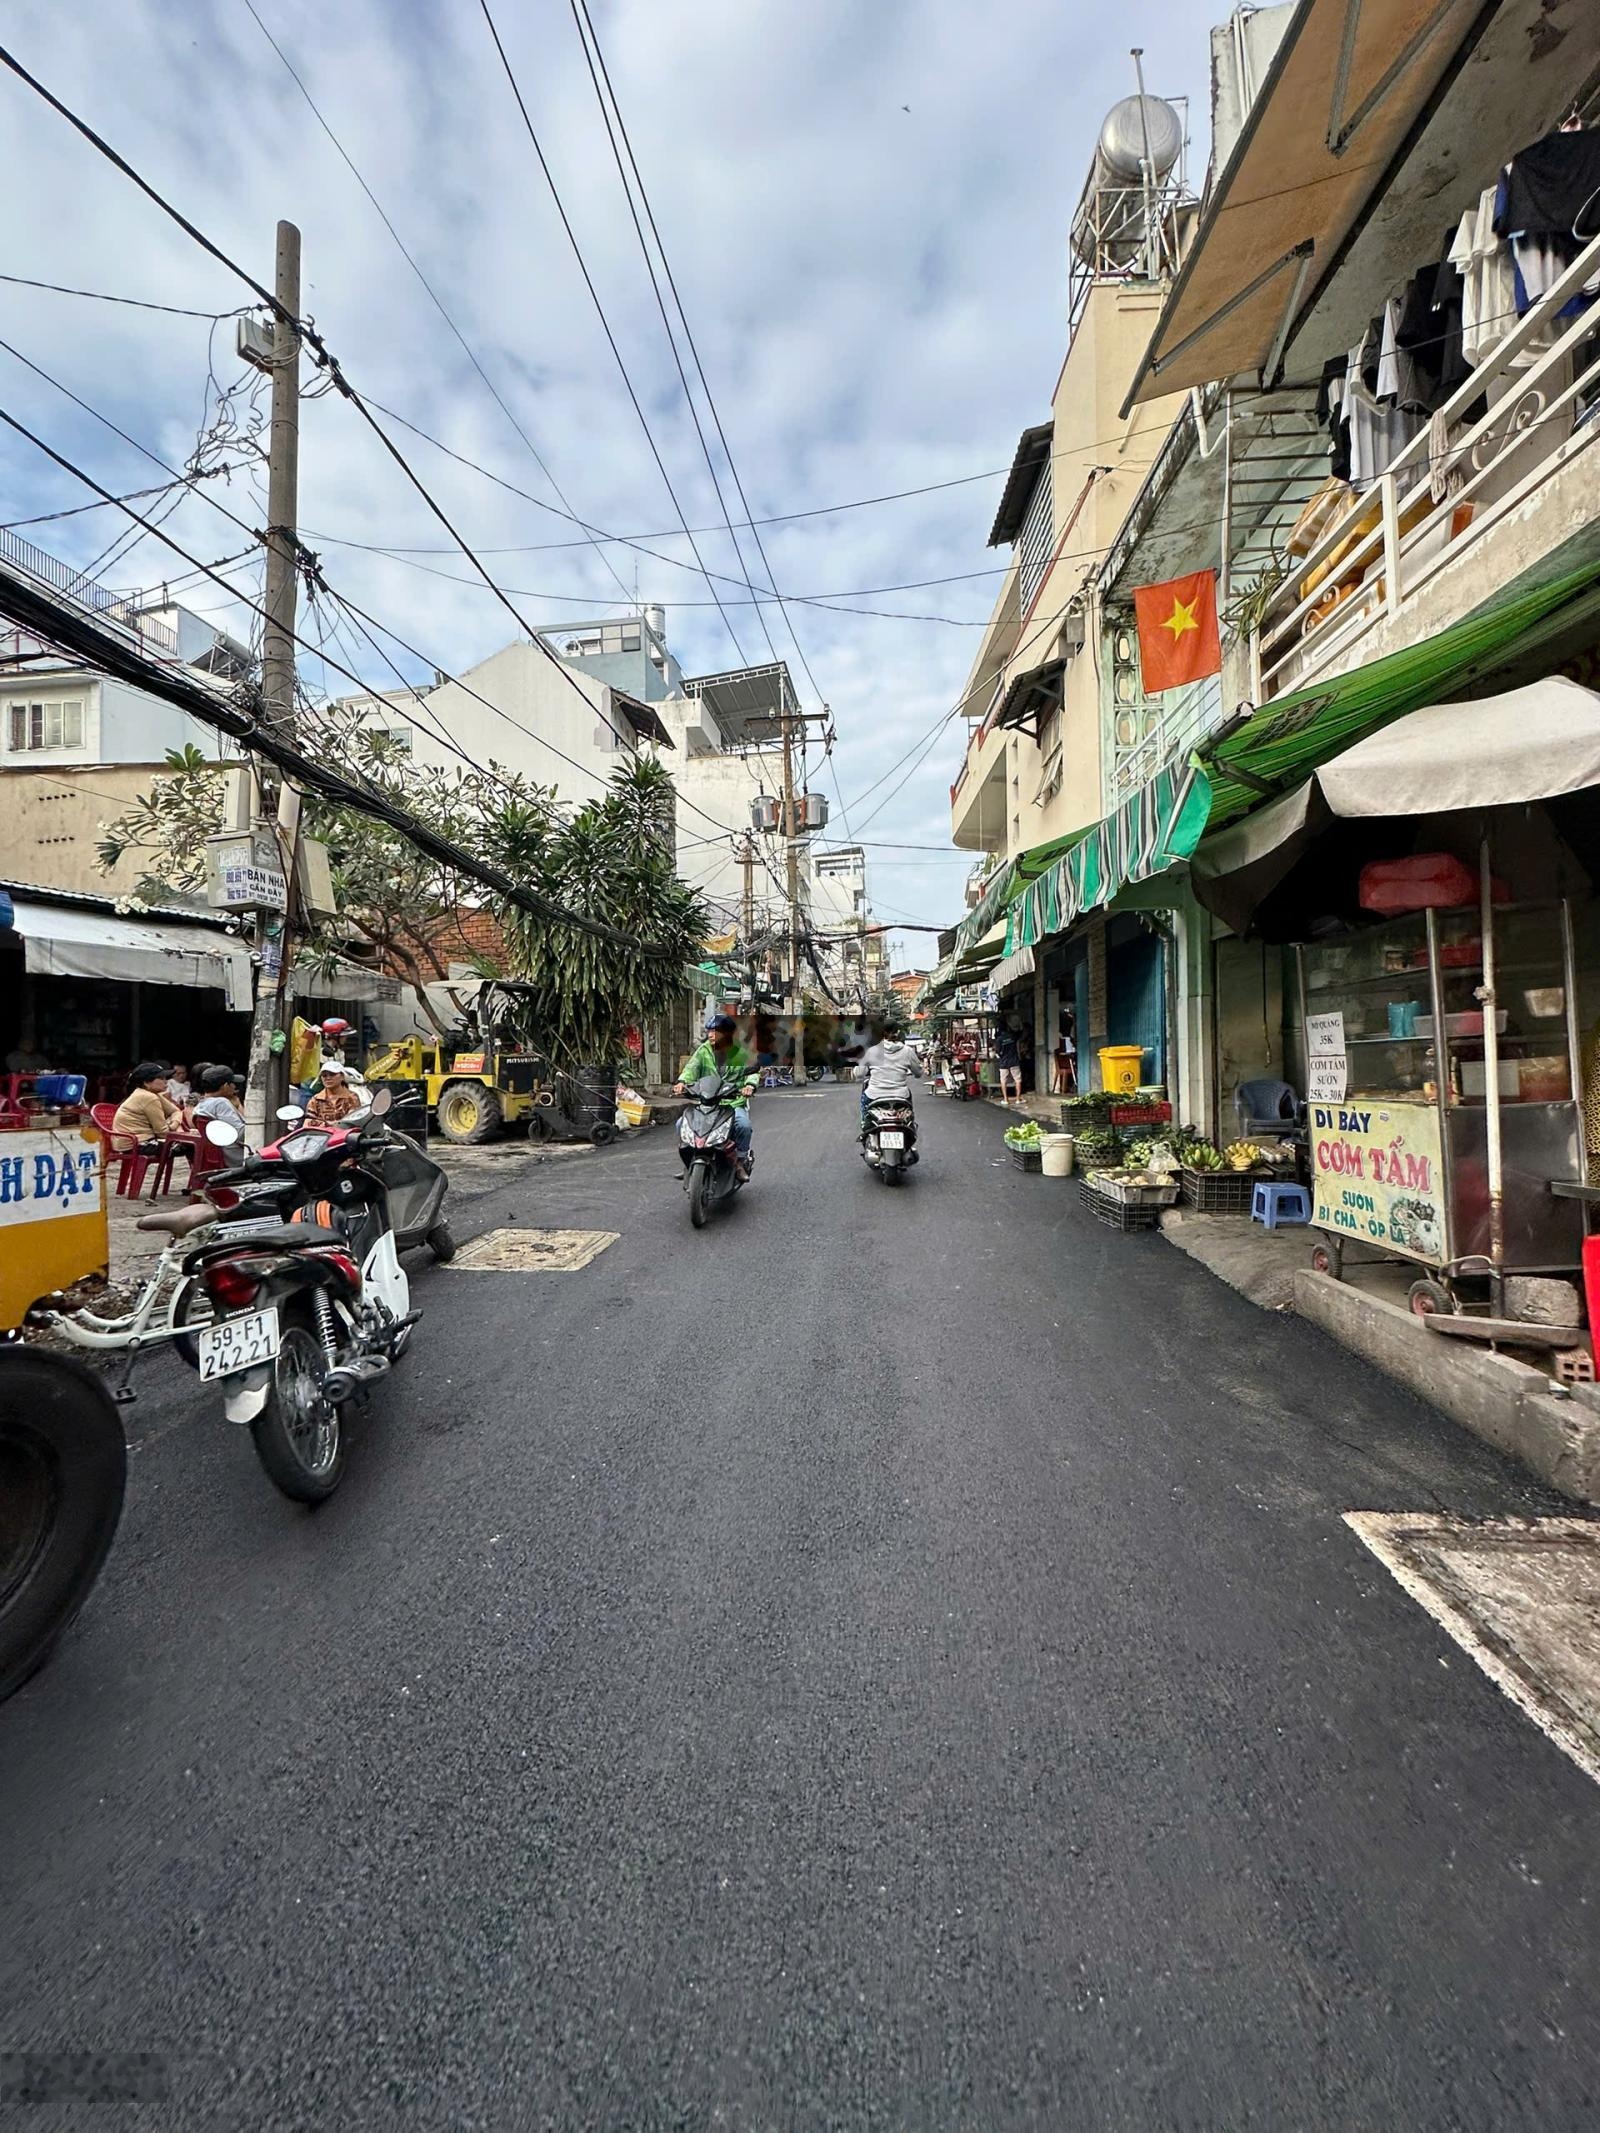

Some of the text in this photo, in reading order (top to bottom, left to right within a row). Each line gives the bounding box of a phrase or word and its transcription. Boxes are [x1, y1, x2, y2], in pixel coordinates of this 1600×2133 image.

[247, 868, 265, 883] BÁN
[1319, 1034, 1333, 1045] 35K
[1329, 1089, 1343, 1101] 30K
[1315, 1107, 1333, 1129] DÌ
[1317, 1135, 1431, 1192] CƠM TẤM
[34, 1150, 97, 1208] ĐẠT
[225, 1306, 255, 1318] HONDA
[212, 1316, 263, 1350] 59-F1
[205, 1335, 272, 1379] 242.21
